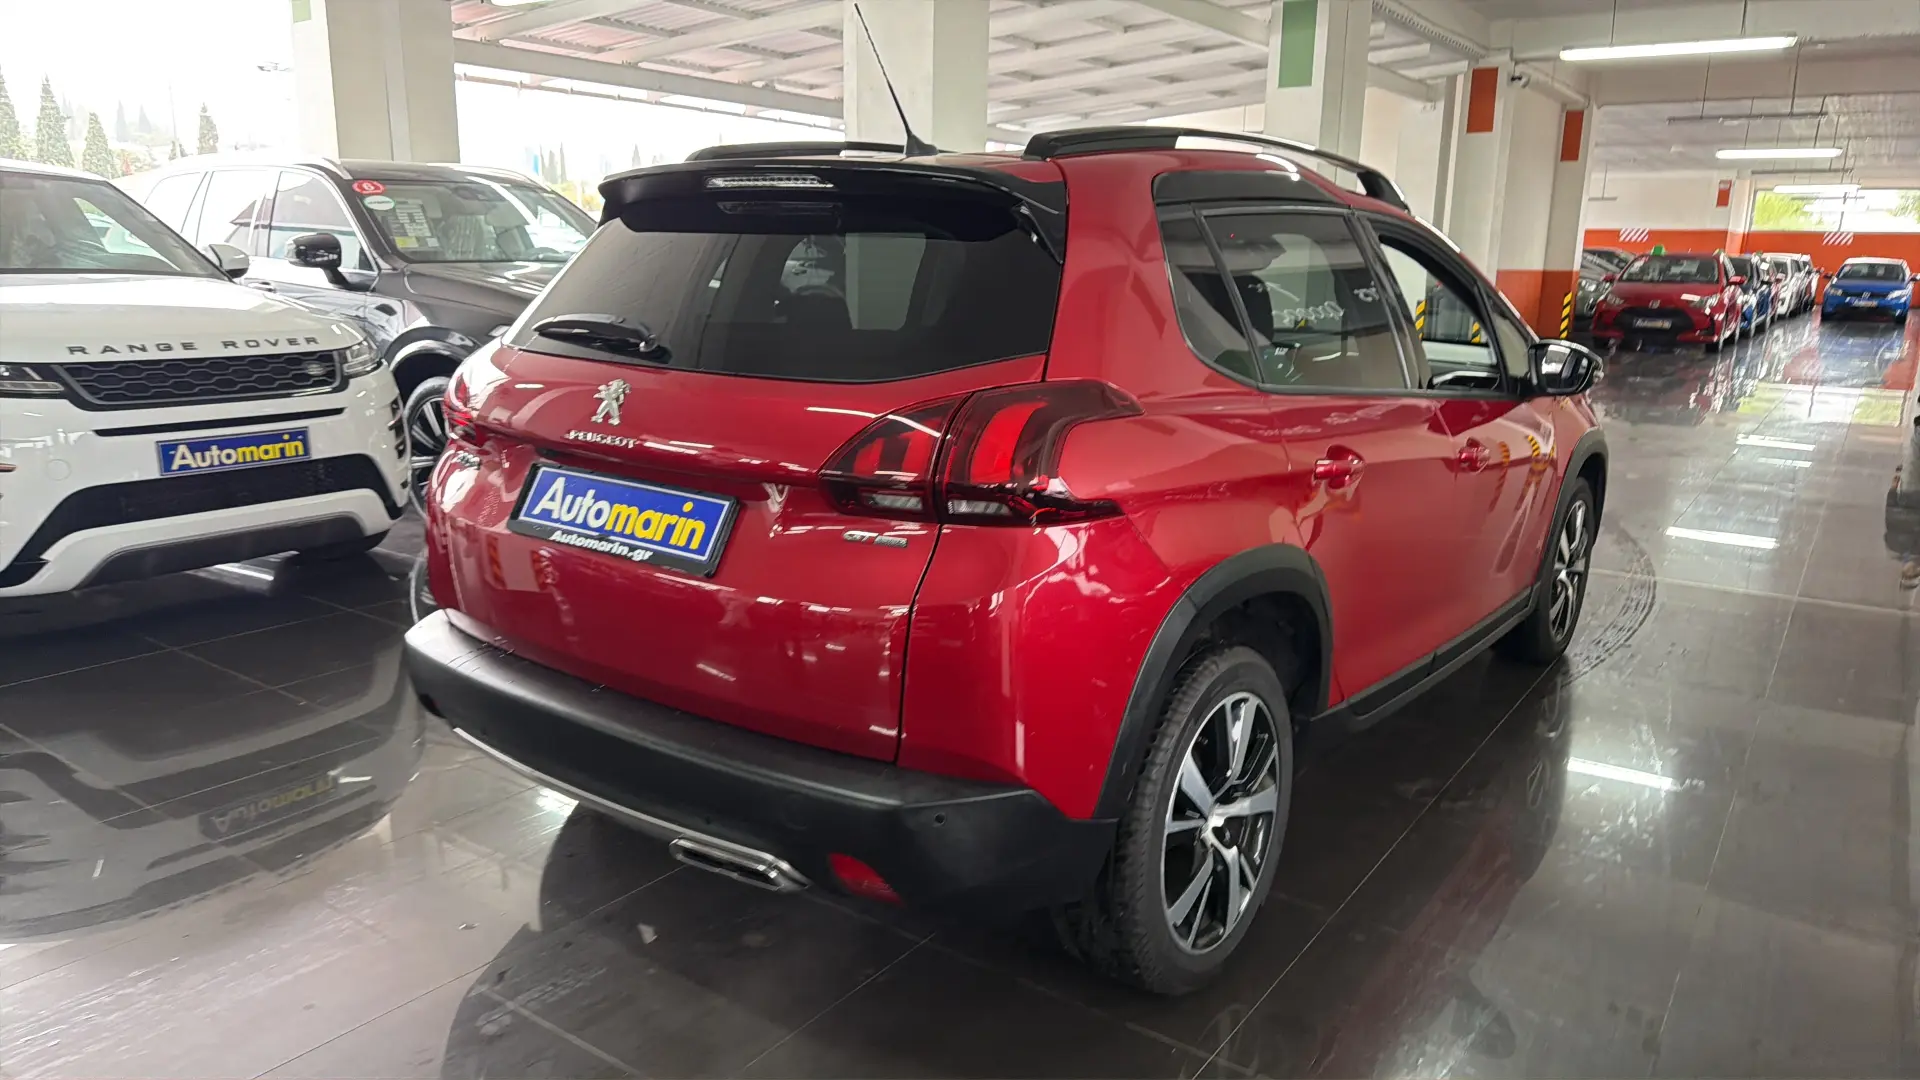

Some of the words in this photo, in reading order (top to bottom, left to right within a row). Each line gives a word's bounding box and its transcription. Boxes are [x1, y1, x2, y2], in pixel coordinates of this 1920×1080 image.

[66, 341, 199, 356] RANGE
[221, 336, 320, 349] ROVER
[171, 434, 304, 471] Automarin
[565, 430, 638, 449] PEUGEOT
[532, 477, 706, 550] Automarin
[550, 530, 653, 561] Automarin.gr
